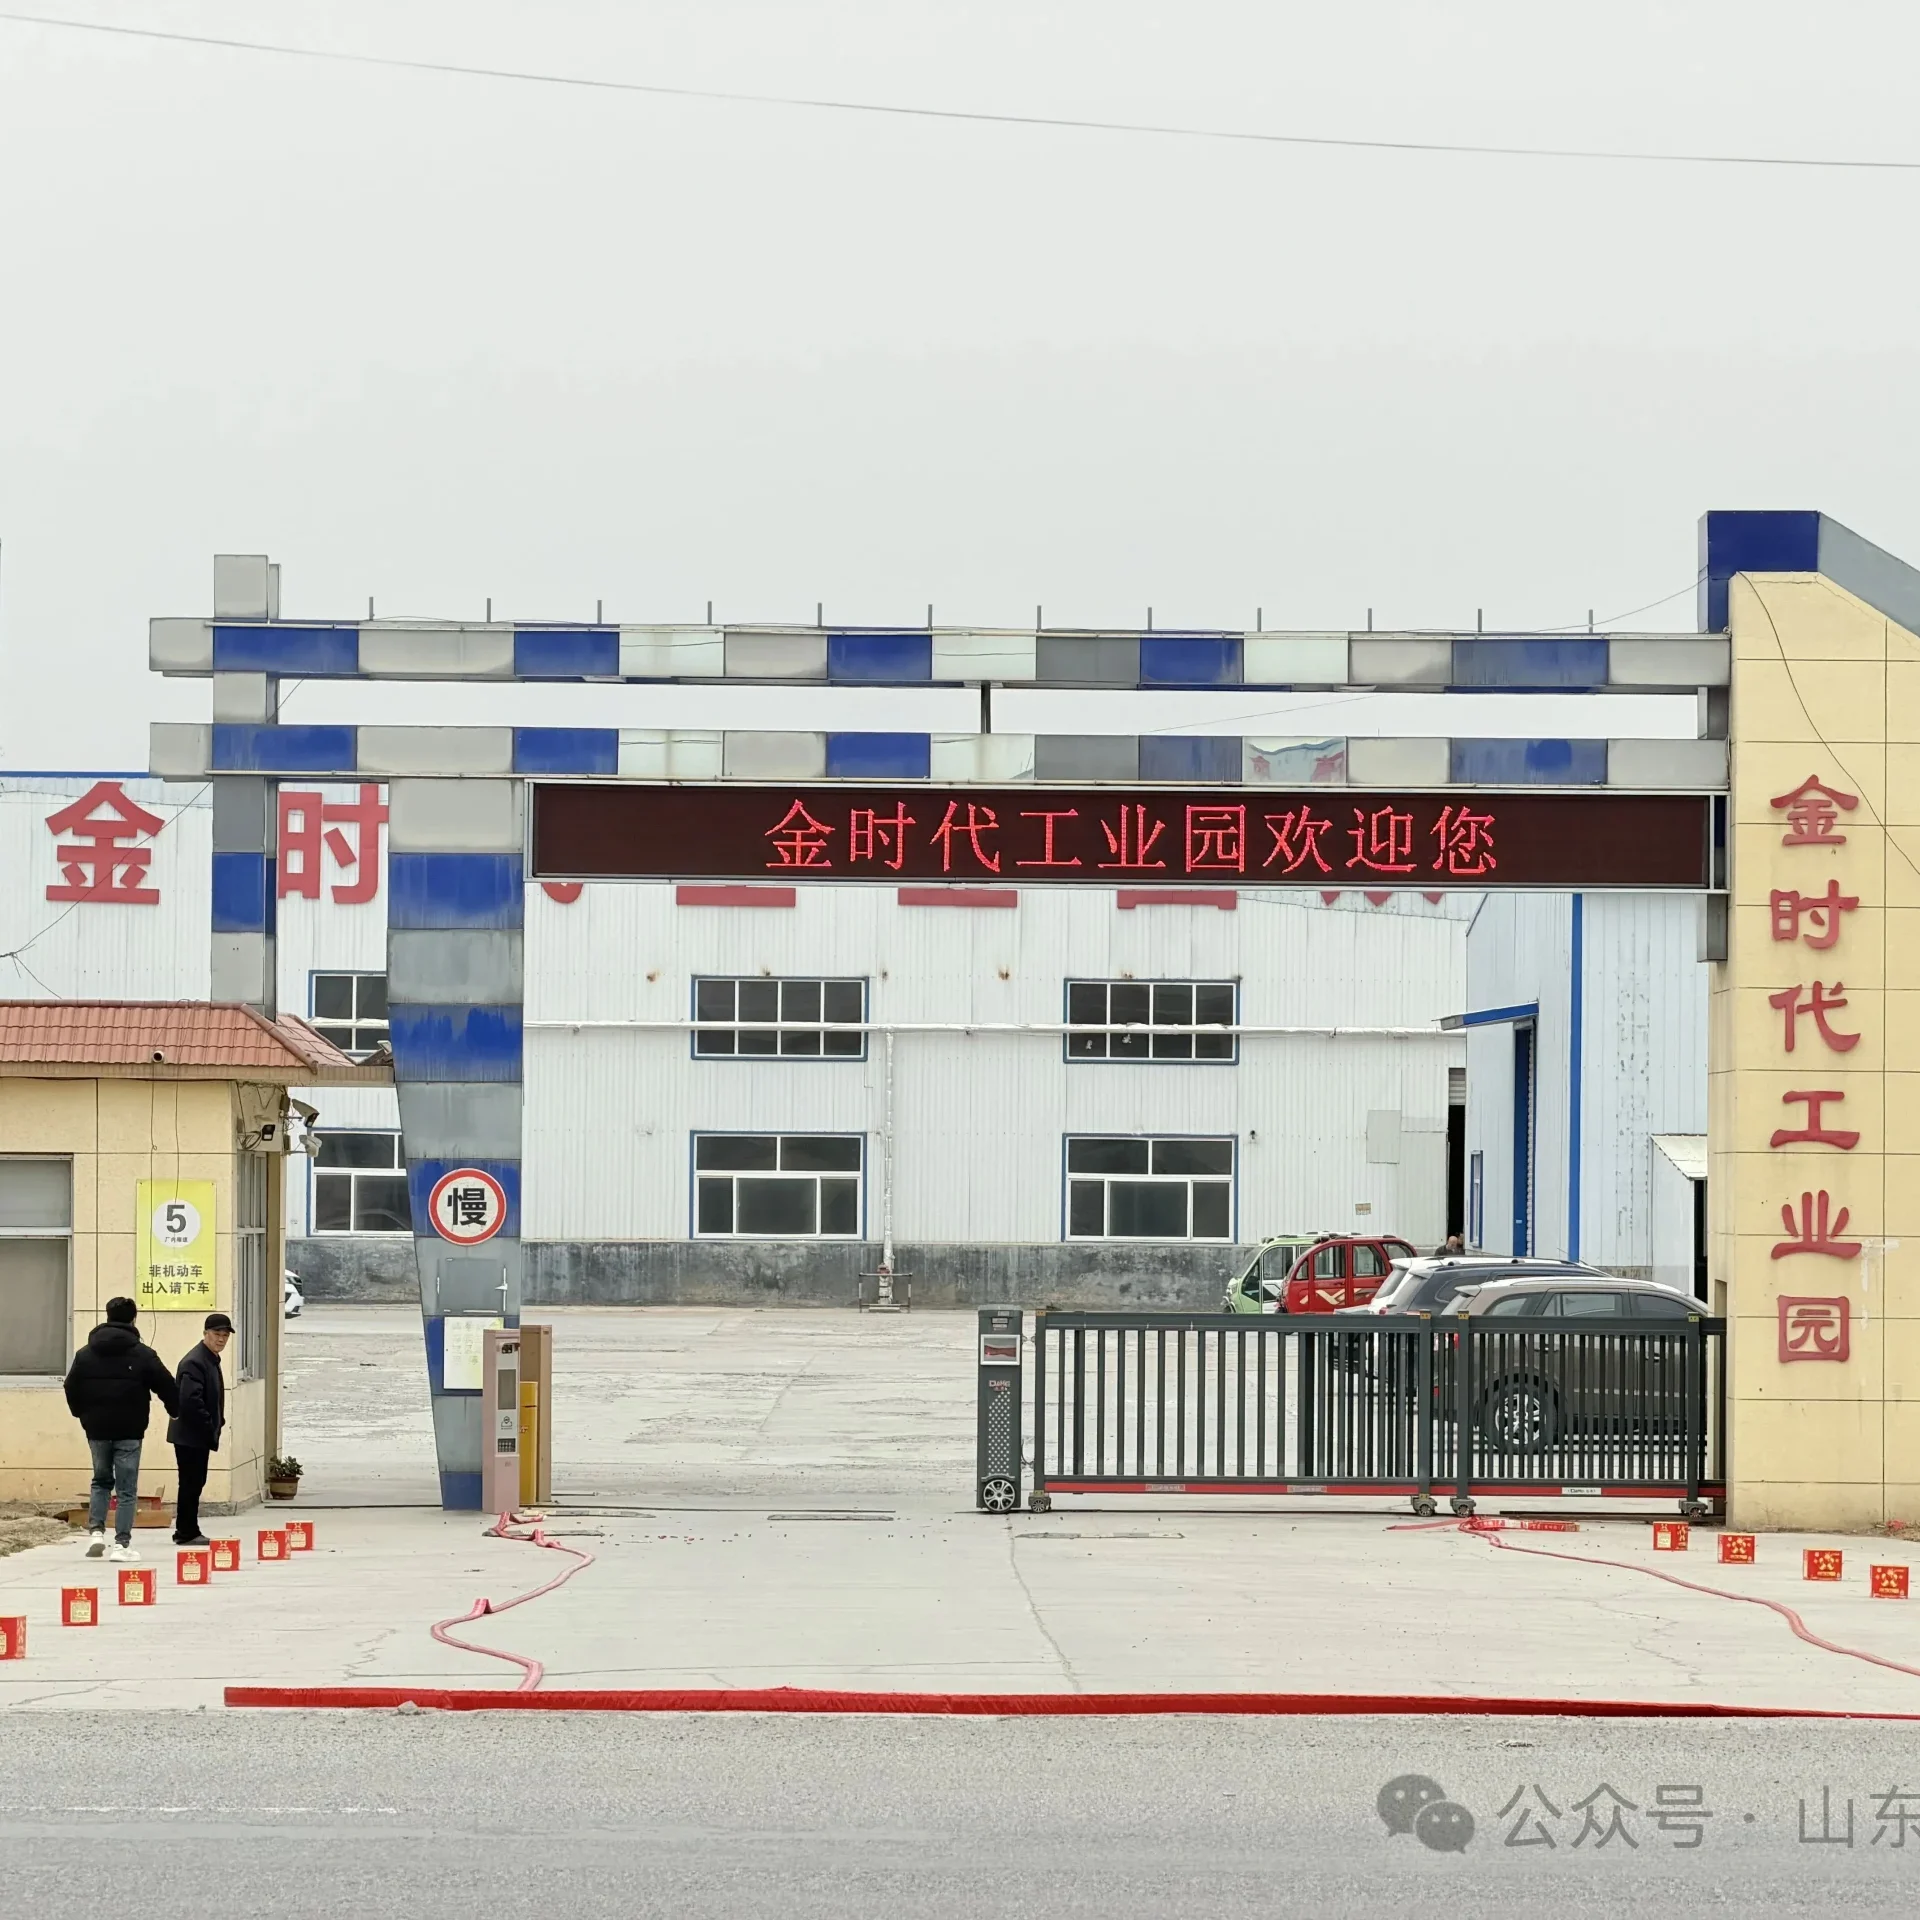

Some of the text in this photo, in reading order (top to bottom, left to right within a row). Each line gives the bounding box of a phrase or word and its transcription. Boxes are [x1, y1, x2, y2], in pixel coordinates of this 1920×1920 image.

[764, 797, 1499, 877] 金时代工业园欢迎您
[1771, 774, 1861, 1362] 金时代工业园
[166, 1204, 187, 1234] 5
[446, 1187, 488, 1227] 慢
[142, 1281, 210, 1295] 出入请下车
[148, 1264, 203, 1278] 非机动车
